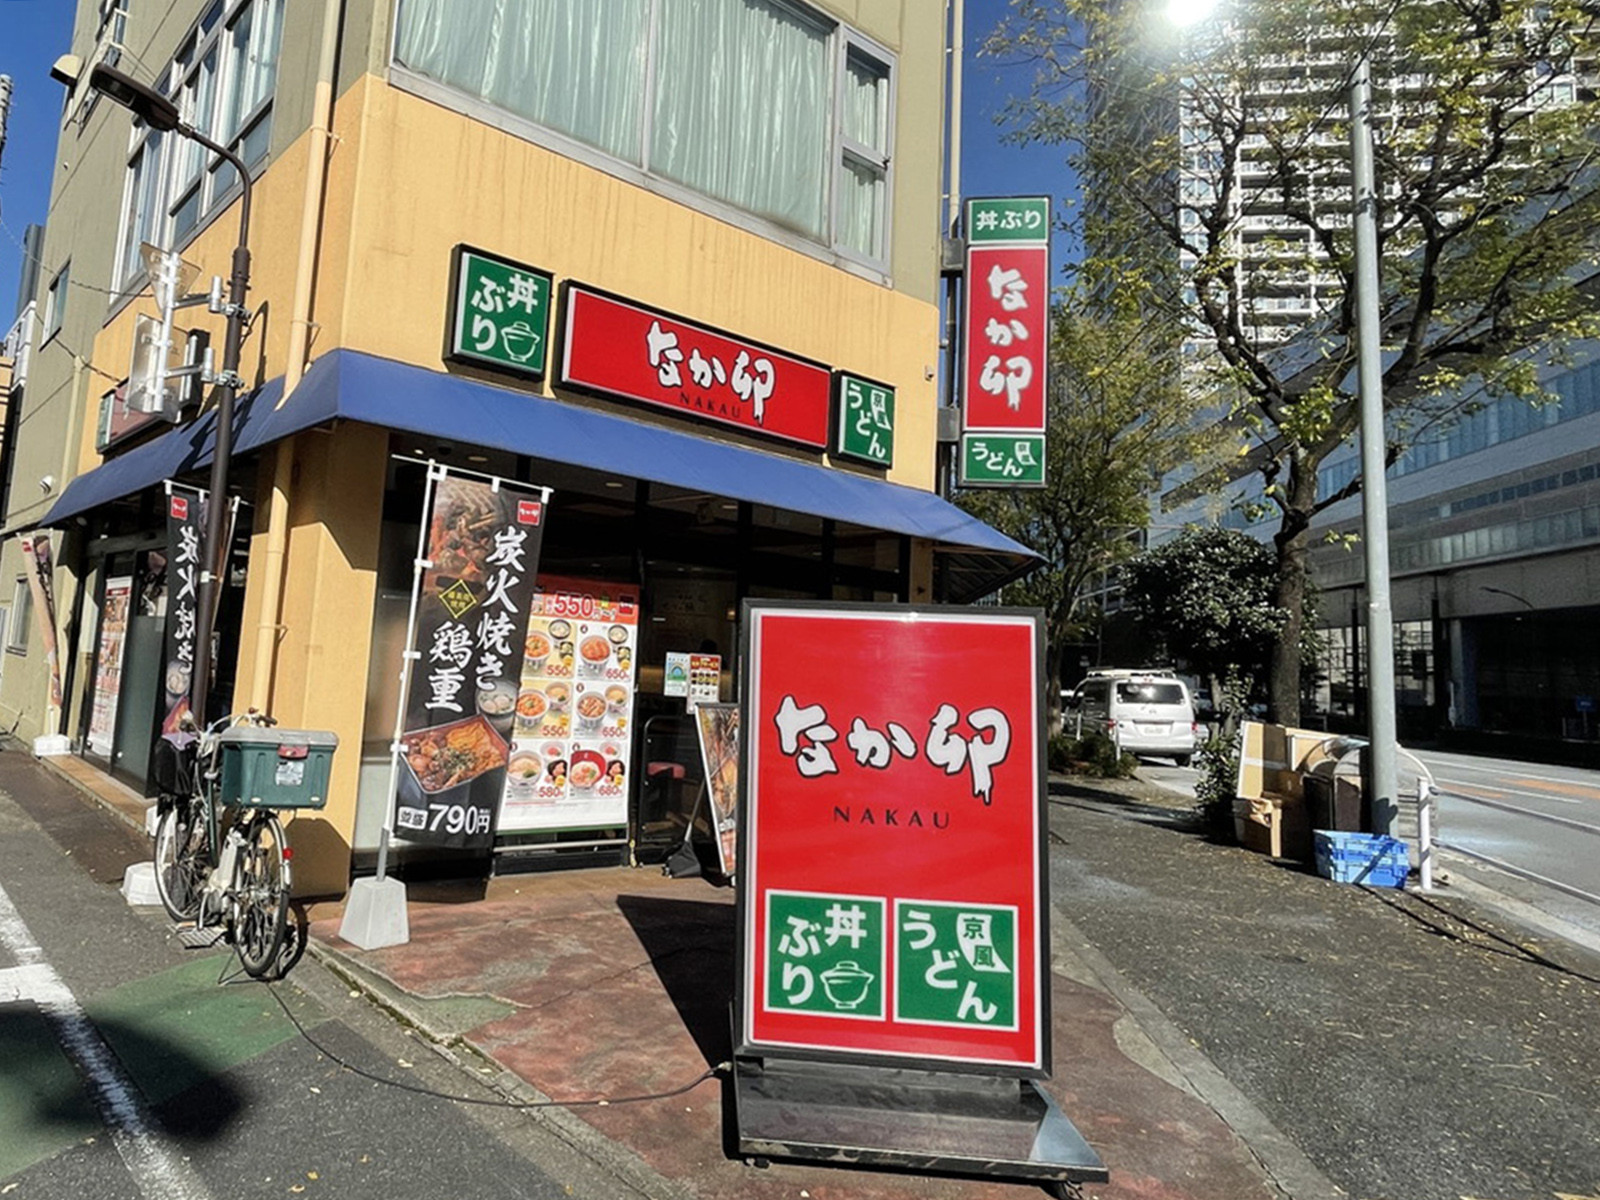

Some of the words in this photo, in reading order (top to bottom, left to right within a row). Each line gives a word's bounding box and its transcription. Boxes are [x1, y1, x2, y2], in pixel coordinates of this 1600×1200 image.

[976, 210, 1041, 230] 丼ぶり
[646, 320, 775, 425] なか卯
[980, 264, 1033, 411] なか卯
[680, 391, 742, 418] NAKAU
[848, 383, 887, 459] うどん
[971, 441, 1024, 477] うどん
[474, 525, 528, 691] 炭火焼き
[424, 620, 473, 713] 鶏重
[774, 694, 1011, 806] なか卯
[834, 806, 950, 829] NAKAU
[903, 910, 998, 1021] うどん
[962, 917, 996, 968] 京風
